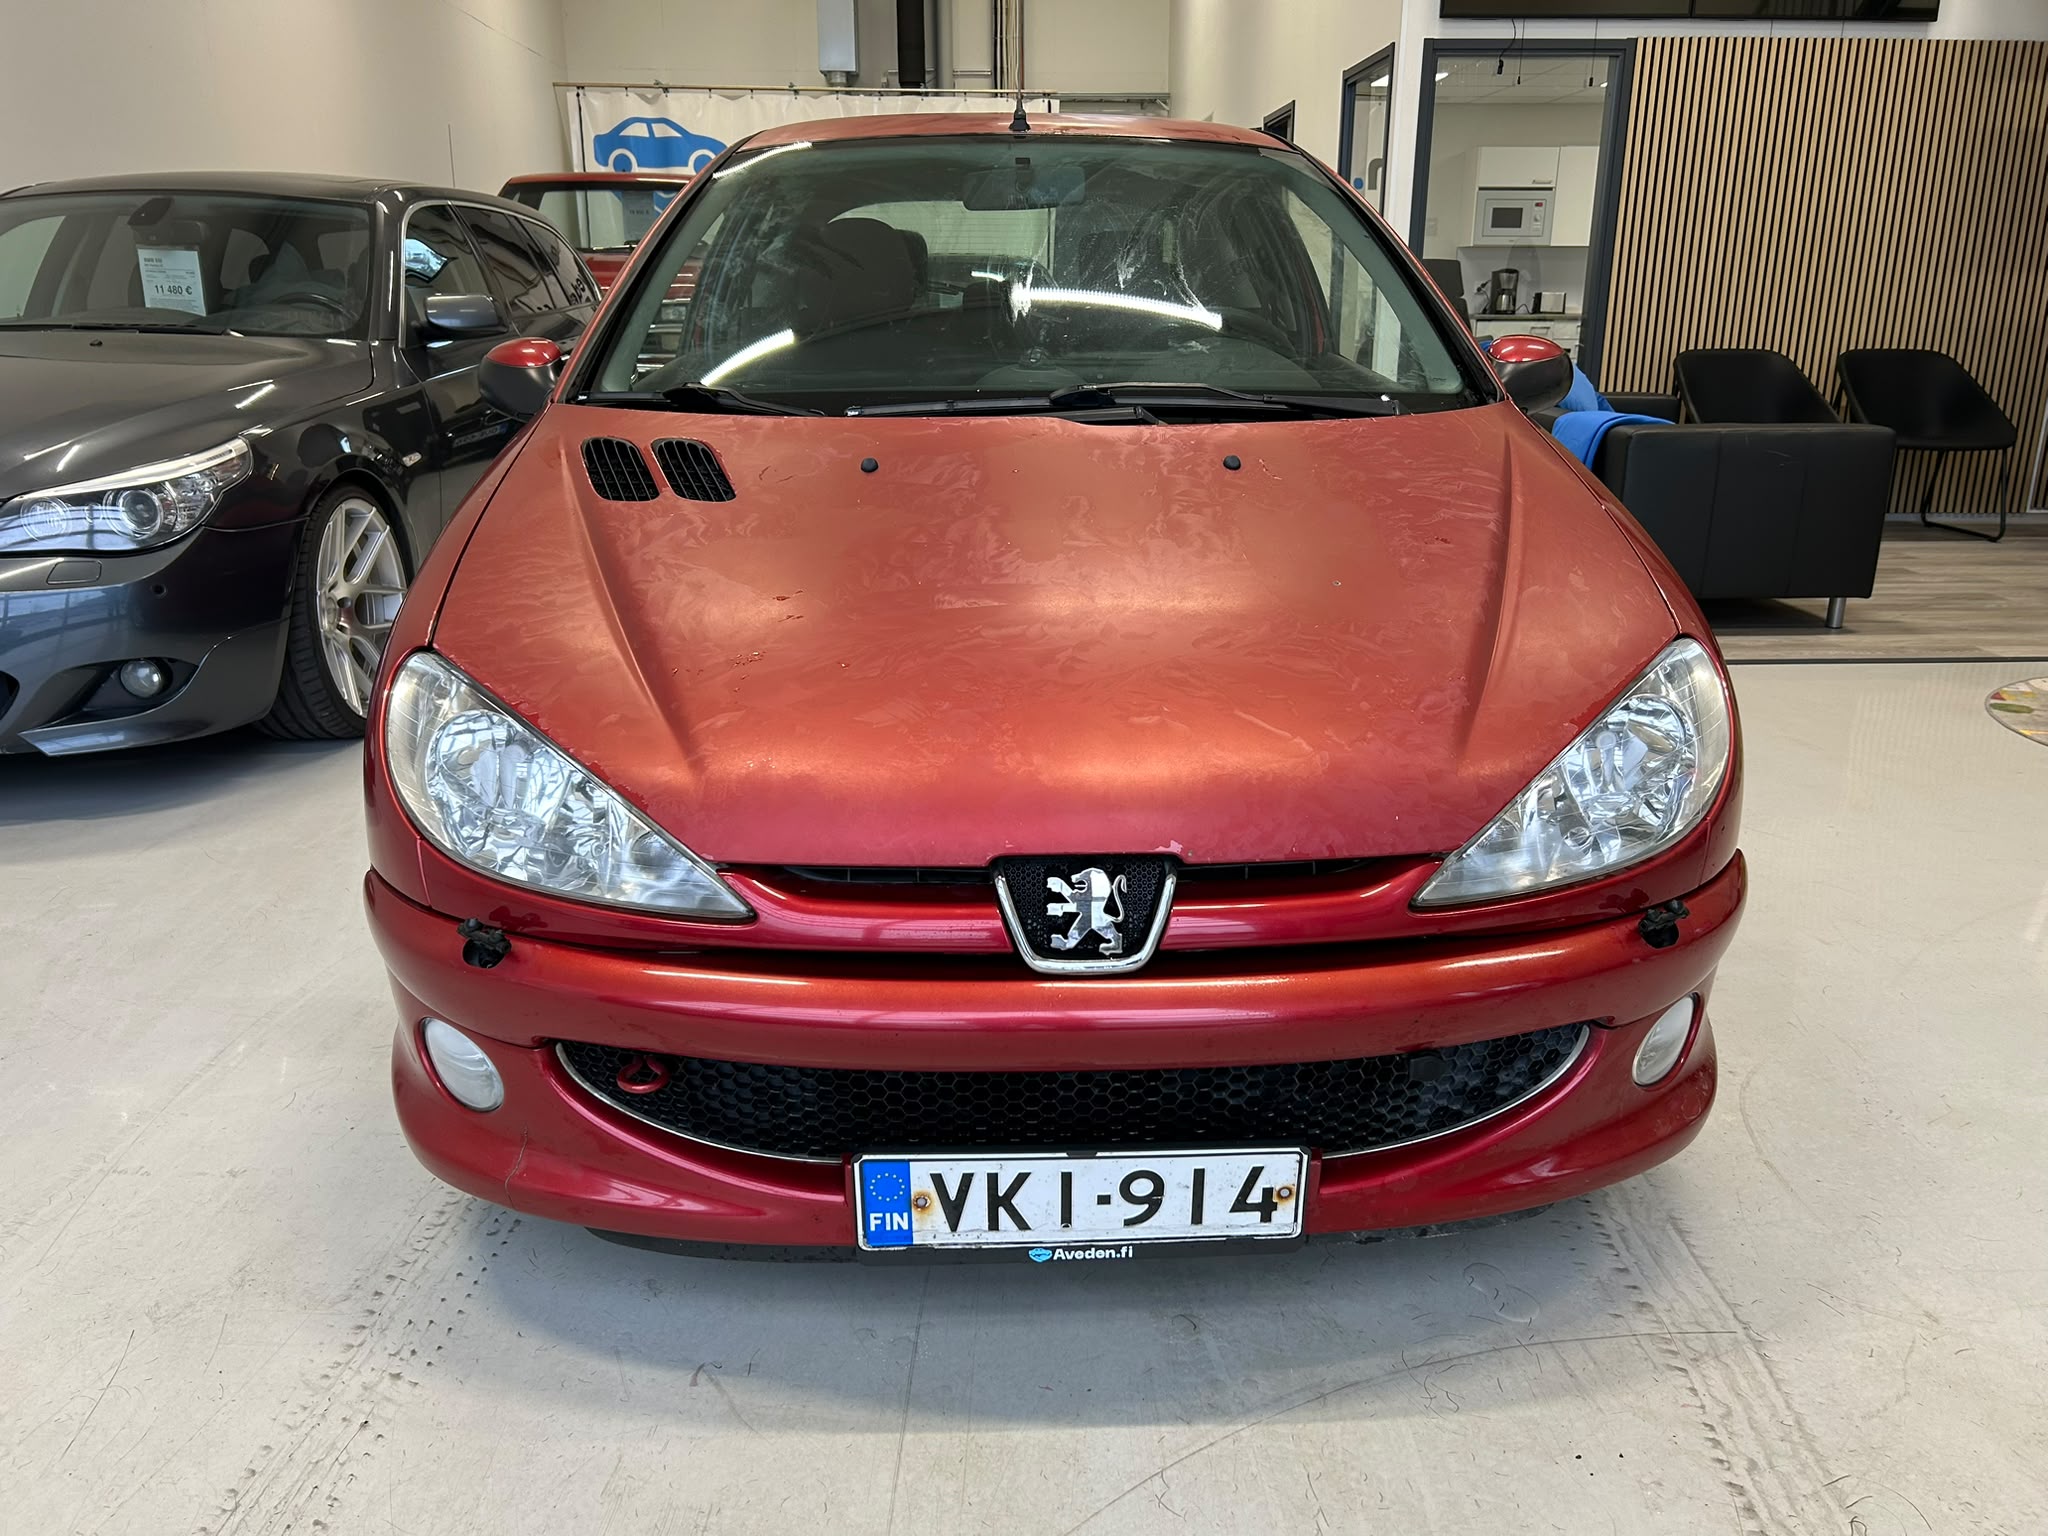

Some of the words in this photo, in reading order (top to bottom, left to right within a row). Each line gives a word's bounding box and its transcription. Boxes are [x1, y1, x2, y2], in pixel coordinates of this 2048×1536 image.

[155, 285, 164, 294] 11
[929, 1165, 1278, 1232] VKI-914
[869, 1212, 909, 1231] FIN
[1053, 1245, 1133, 1260] Aveden.fi
